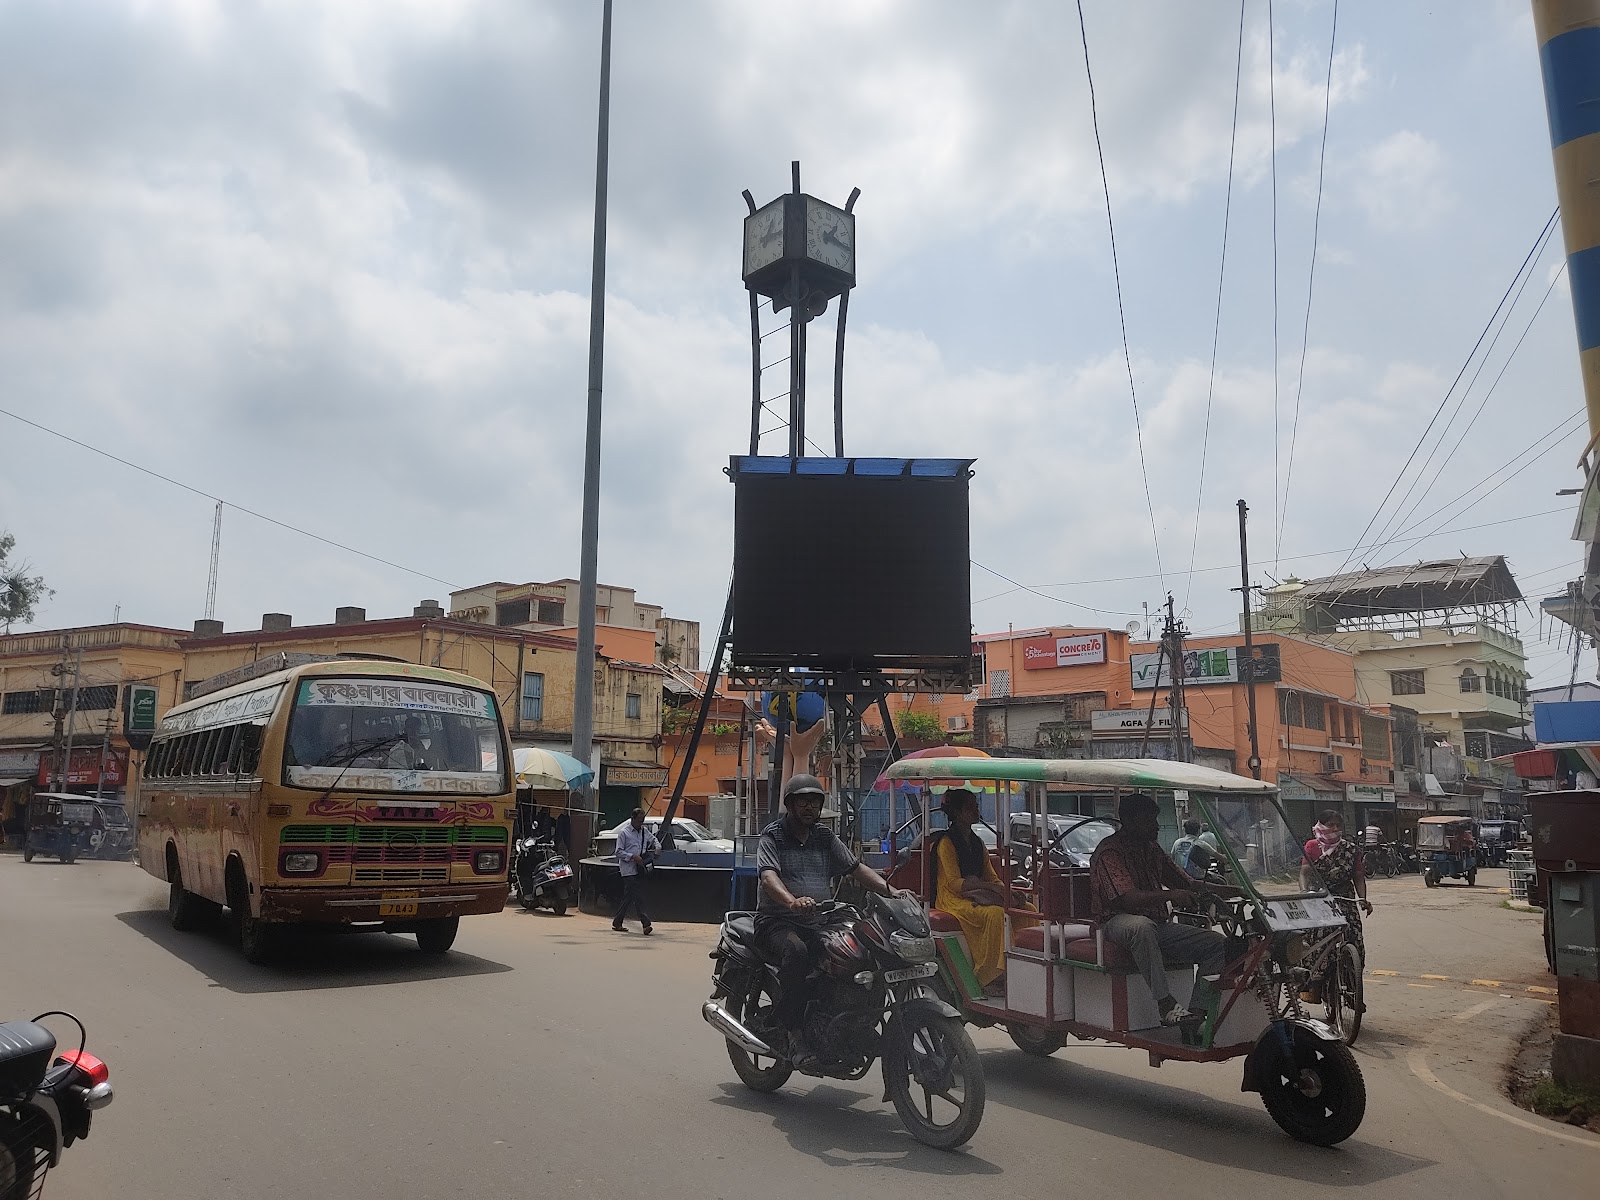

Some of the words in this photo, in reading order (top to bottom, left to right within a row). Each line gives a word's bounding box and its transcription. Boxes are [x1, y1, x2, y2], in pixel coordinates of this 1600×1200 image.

[317, 683, 401, 703] কৃষ্ণনগর
[401, 686, 478, 710] বাবলারী
[380, 807, 434, 818] TATA
